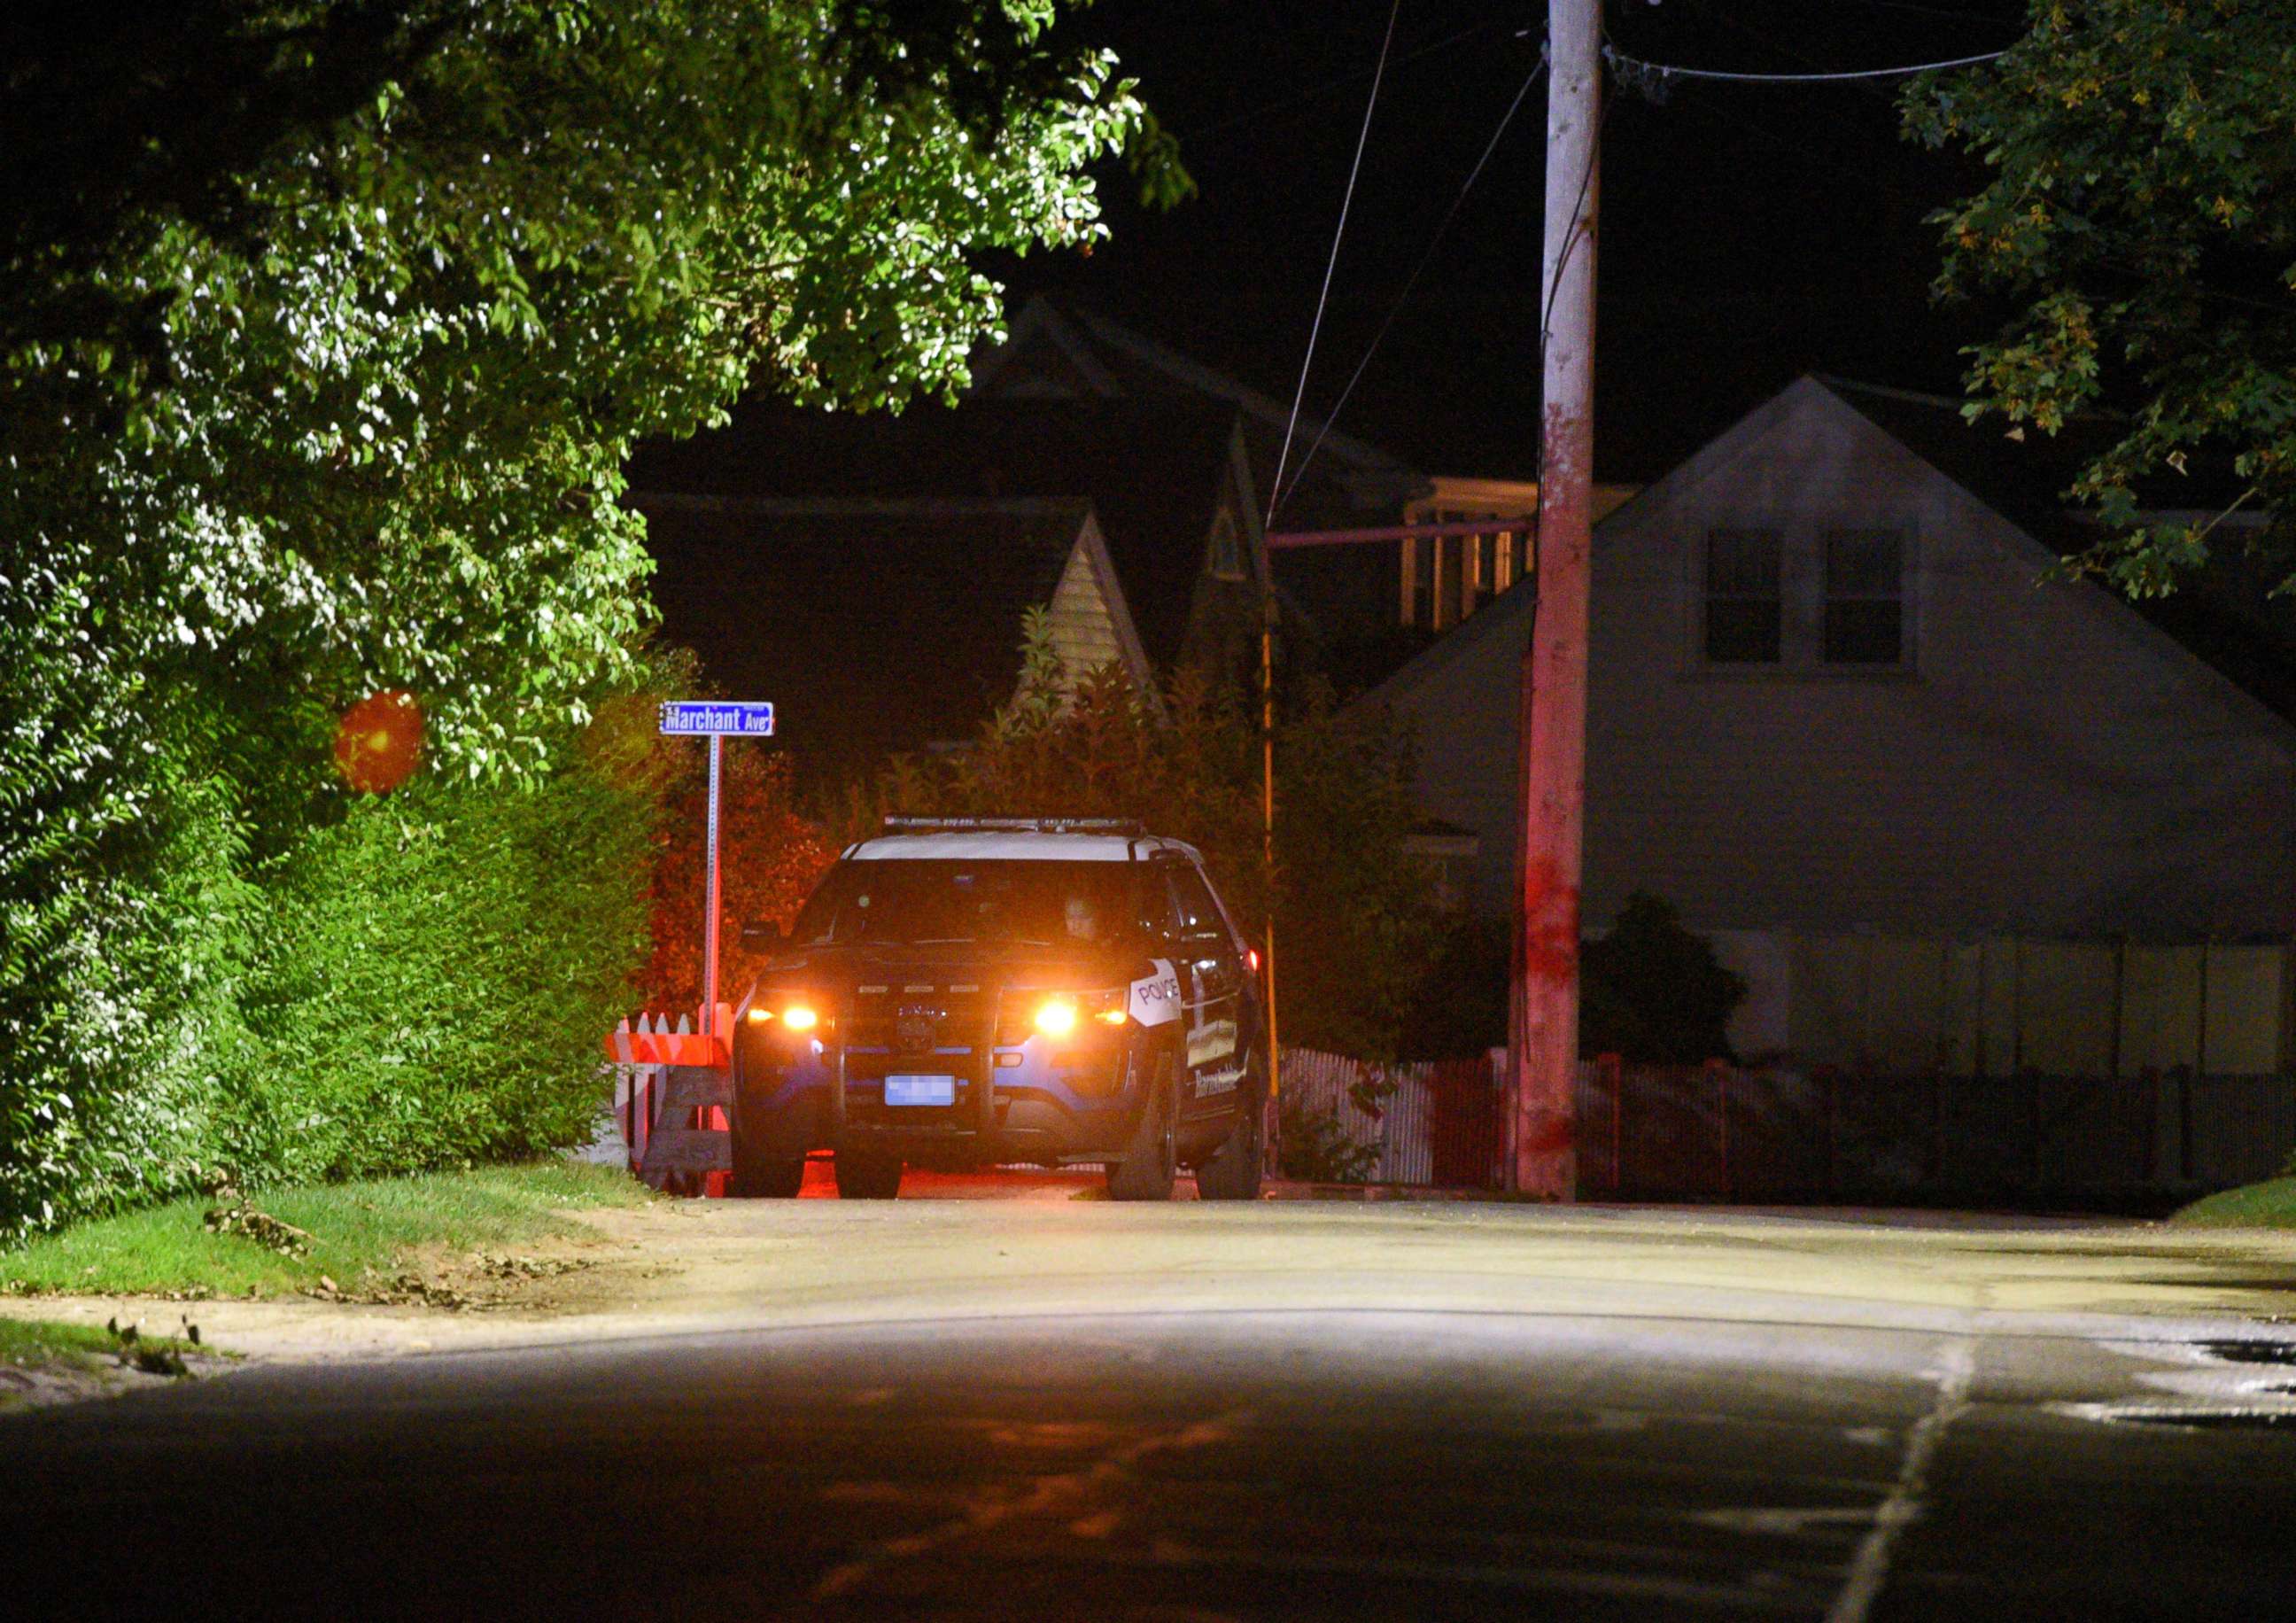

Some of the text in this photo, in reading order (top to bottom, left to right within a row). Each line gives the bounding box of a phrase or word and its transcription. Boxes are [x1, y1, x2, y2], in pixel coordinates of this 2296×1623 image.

[665, 706, 767, 731] Marchant Ave
[1138, 978, 1179, 1006] POLICE
